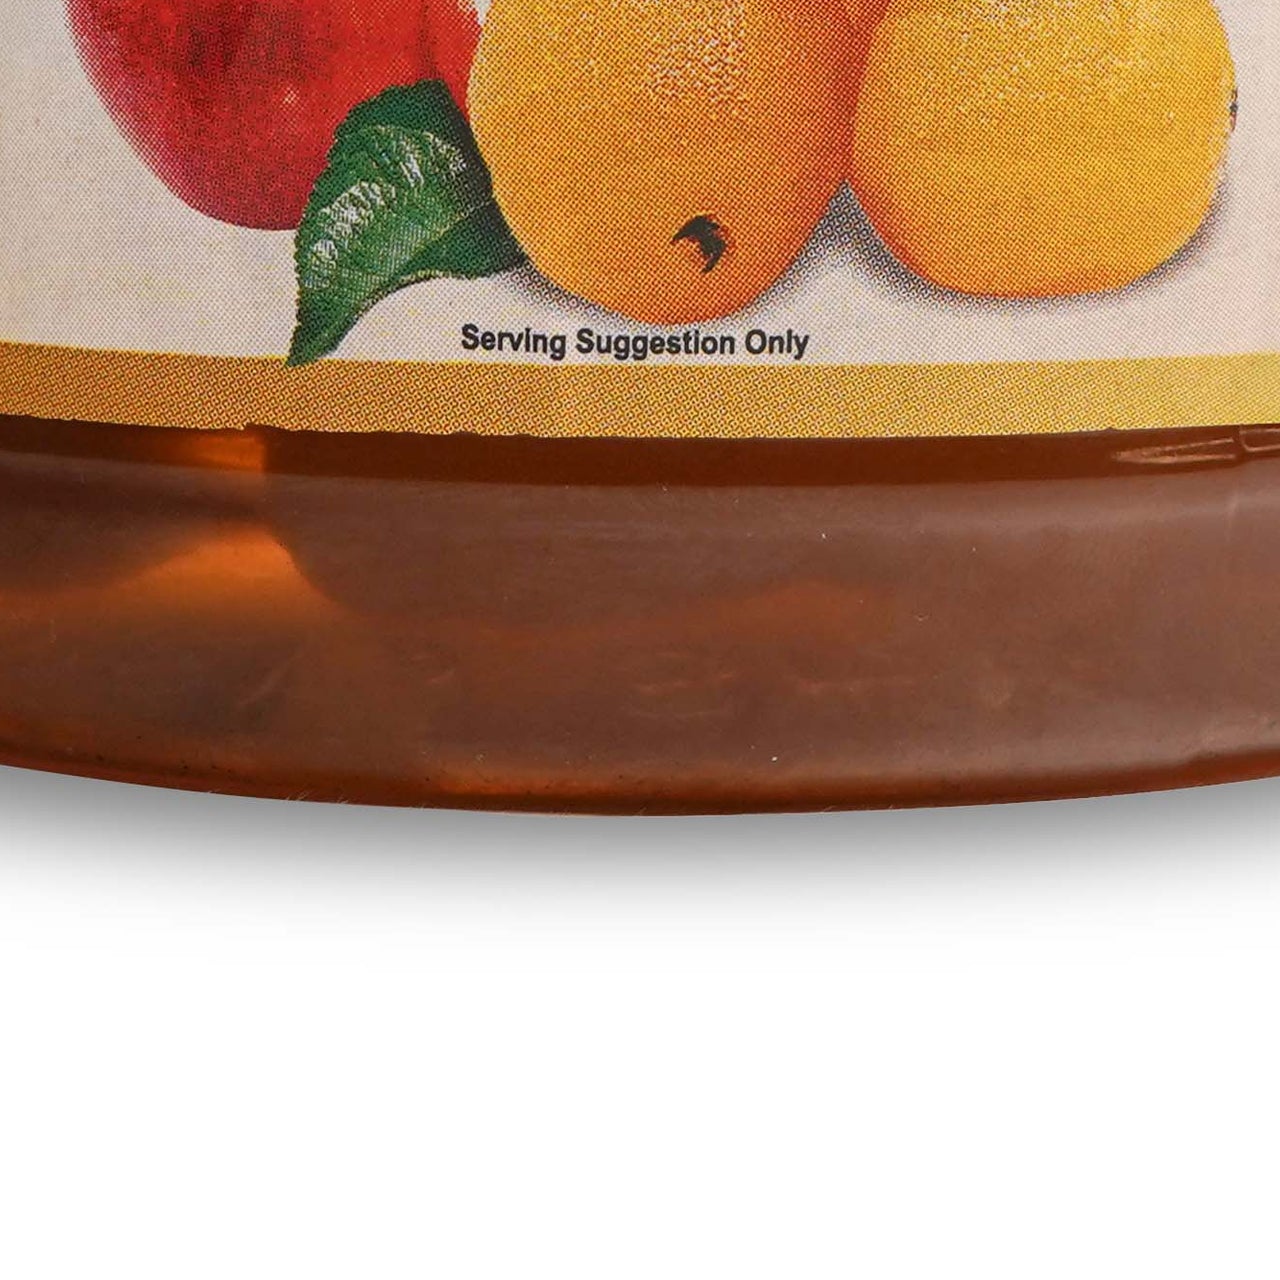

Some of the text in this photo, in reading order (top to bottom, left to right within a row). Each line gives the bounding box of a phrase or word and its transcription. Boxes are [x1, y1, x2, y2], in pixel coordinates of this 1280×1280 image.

[460, 322, 810, 361] Serving Suggestion Only
